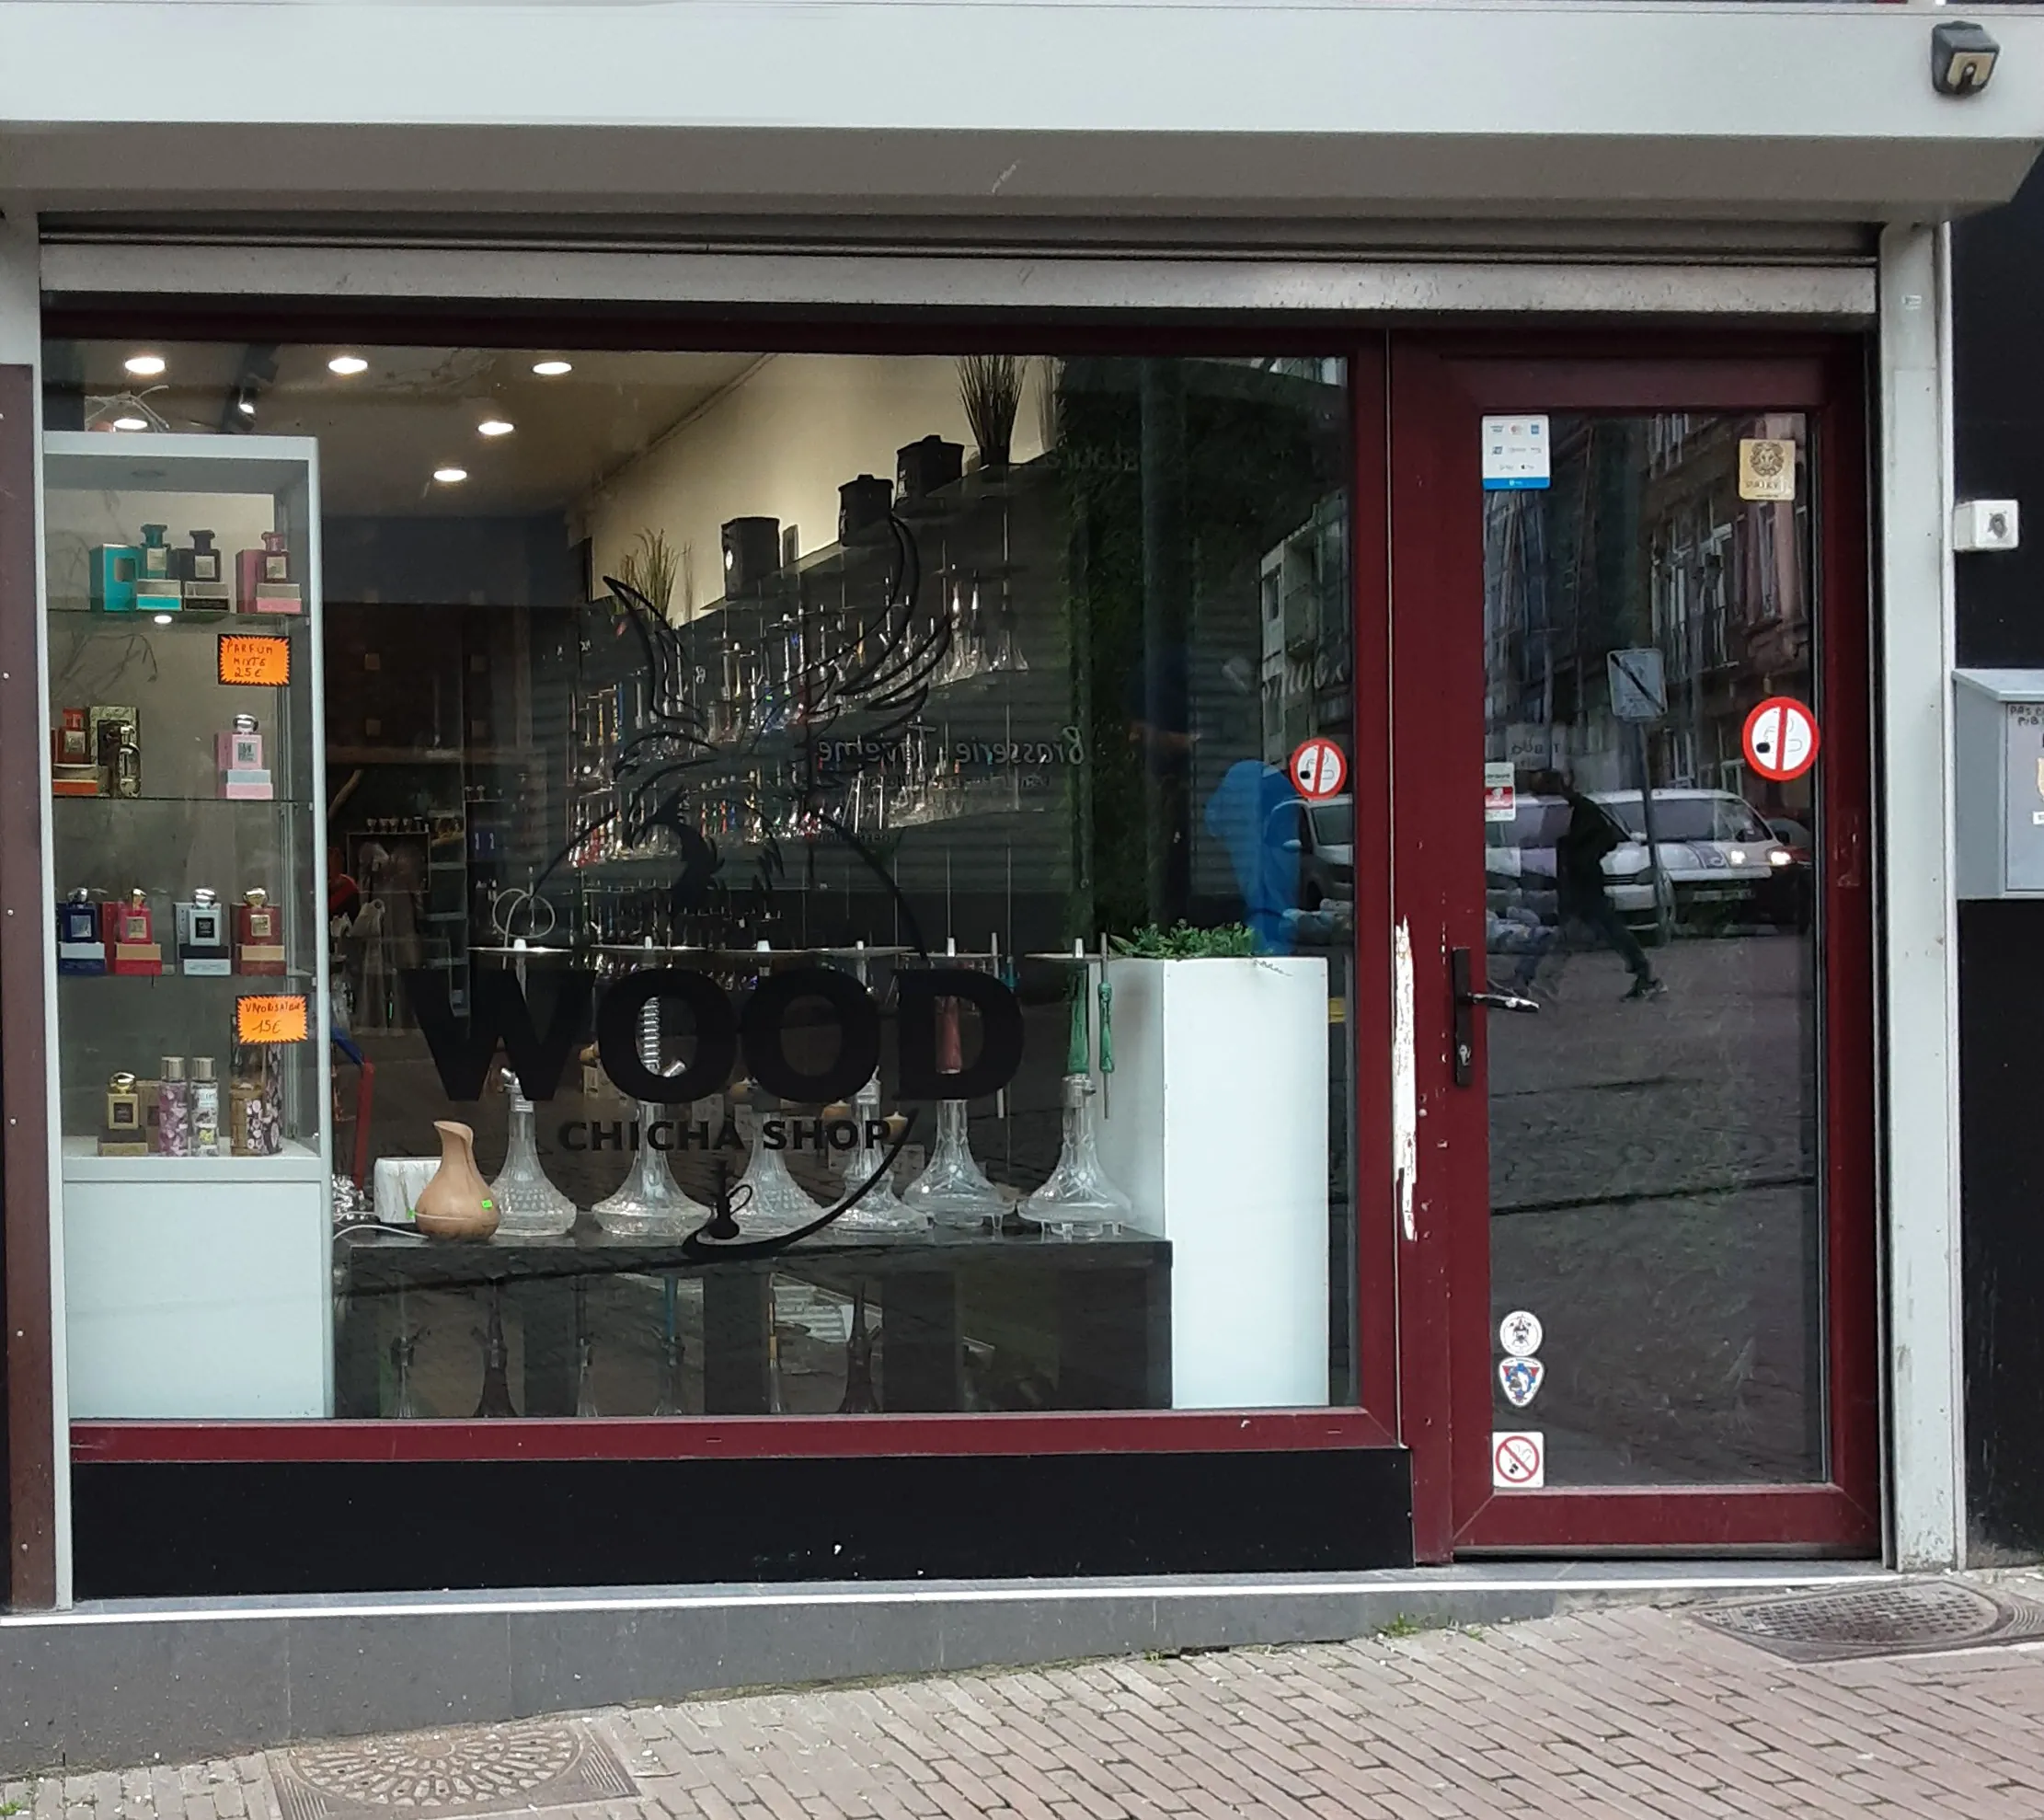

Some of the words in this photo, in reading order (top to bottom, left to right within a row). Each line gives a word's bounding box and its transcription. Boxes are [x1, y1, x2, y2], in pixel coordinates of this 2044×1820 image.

[226, 639, 272, 654] PARFUM
[252, 1019, 281, 1033] 15€
[403, 967, 1024, 1103] WOOD
[558, 1119, 743, 1151] CHICHA
[764, 1118, 892, 1151] SHOP
